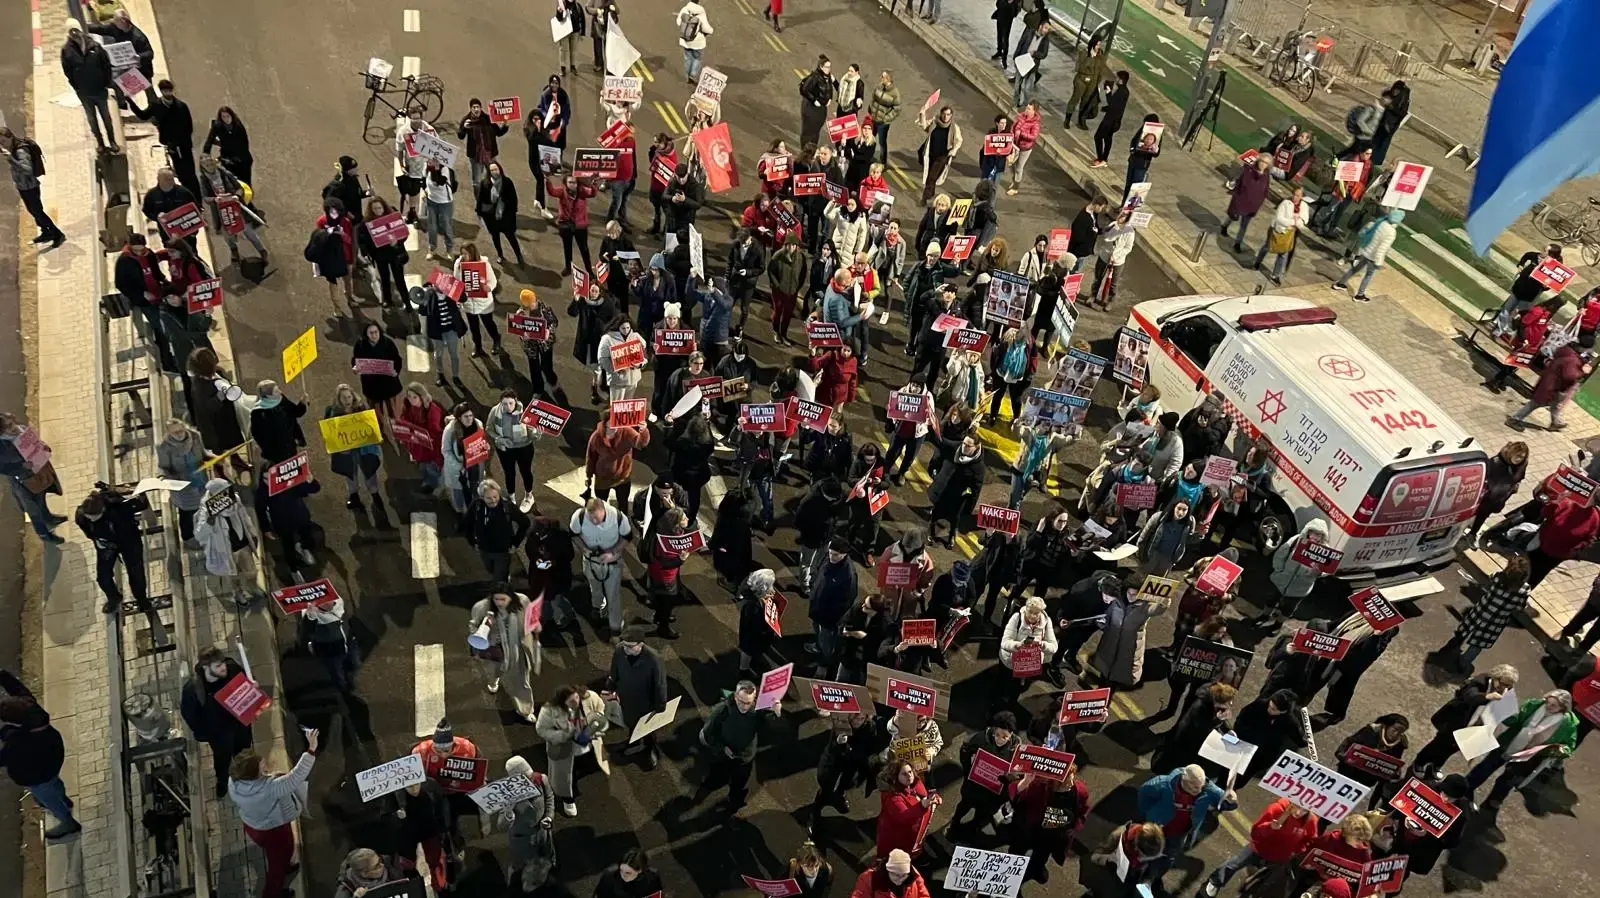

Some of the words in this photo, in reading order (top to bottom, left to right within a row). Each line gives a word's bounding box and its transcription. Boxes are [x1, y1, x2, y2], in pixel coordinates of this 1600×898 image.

[952, 205, 967, 218] NO
[666, 332, 683, 340] כולם
[684, 332, 692, 340] את
[630, 343, 640, 353] SAY
[1230, 360, 1248, 380] DAVID
[1234, 352, 1256, 376] MAGEN
[1224, 366, 1244, 386] ADOM
[1220, 374, 1228, 383] IN
[1228, 380, 1248, 402] ISRAEL
[798, 401, 810, 409] להן
[898, 394, 908, 404] להן
[908, 396, 922, 404] נגמר
[1348, 389, 1398, 410] ירקון
[613, 402, 634, 412] WAKE
[634, 401, 645, 410] UP
[750, 407, 760, 416] להן
[760, 406, 775, 414] נגמר
[810, 404, 824, 414] נגמר
[898, 404, 918, 412] הזמן!
[614, 411, 640, 426] NOW!
[752, 416, 774, 424] הזמן!
[798, 408, 820, 420] הזמן!
[1299, 413, 1314, 430] דוד
[1370, 410, 1438, 434] 1442
[1310, 428, 1328, 444] מגן
[1282, 430, 1313, 464] בישראל
[1298, 432, 1322, 454] אדום
[1332, 448, 1364, 472] ירקון
[1323, 466, 1348, 492] 1442
[1292, 472, 1302, 483] OF
[1328, 508, 1348, 527] ADOM
[982, 506, 1004, 518] WAKE
[1006, 512, 1018, 520] UP
[1385, 514, 1460, 536] AMBULANCE
[672, 542, 692, 551] הזמן!
[1310, 544, 1328, 557] כולם
[1301, 549, 1327, 564] עכשיו!
[1328, 552, 1342, 561] את
[1352, 549, 1376, 562] 1442
[1378, 548, 1408, 559] ירקון
[1143, 582, 1172, 598] NO
[1370, 594, 1384, 606] להן
[1364, 600, 1384, 621] הזמן!
[1380, 604, 1394, 618] נגמר
[1304, 640, 1336, 652] עכשיו!
[1312, 634, 1340, 646] עסקה
[1178, 664, 1192, 676] FOR
[1188, 659, 1200, 668] ARE
[822, 686, 842, 695] כולם
[842, 690, 853, 698] את
[922, 692, 932, 700] איך
[820, 694, 844, 702] עכשיו!
[894, 690, 926, 705] בלעדיהן?
[896, 736, 924, 750] SISTER
[898, 748, 924, 760] SISTER
[1020, 753, 1044, 763] וחטופים
[446, 758, 475, 770] עסקה
[1034, 762, 1064, 774] תחילה!
[1044, 758, 1067, 769] חטופות
[362, 762, 400, 780] החטופים
[373, 766, 411, 784] בסכנה
[440, 767, 473, 780] עכשיו!
[394, 770, 423, 786] עסקה
[1336, 784, 1363, 802] הם
[1406, 790, 1430, 808] וחטופים
[1323, 801, 1348, 819] הן
[1428, 806, 1450, 823] חטופות
[1414, 806, 1444, 830] תחילה!
[1012, 857, 1026, 866] כל
[1372, 861, 1393, 874] כולם
[1392, 860, 1404, 870] את
[1000, 867, 1024, 876] אחת
[954, 876, 980, 890] עכשיו!
[1366, 872, 1390, 885] עכשיו!
[984, 882, 1012, 896] עסקה
